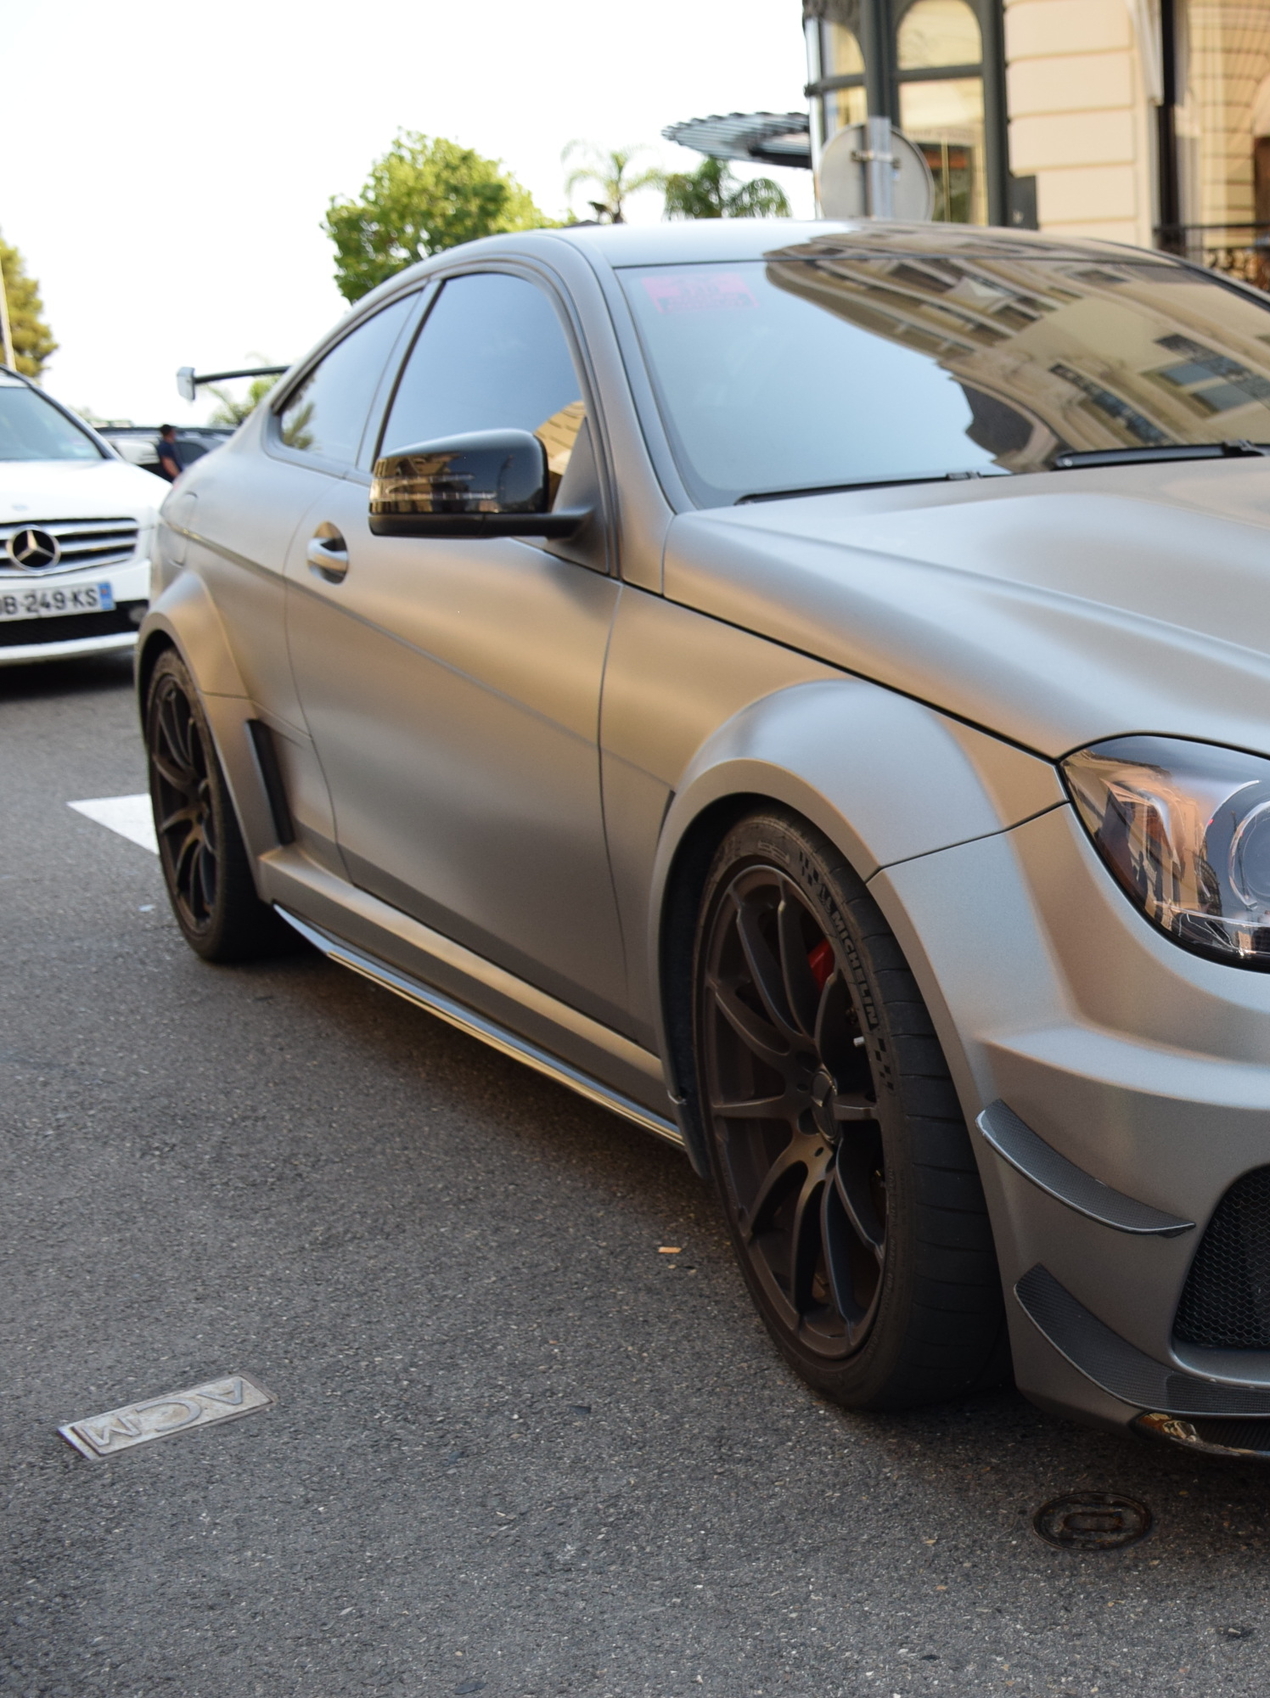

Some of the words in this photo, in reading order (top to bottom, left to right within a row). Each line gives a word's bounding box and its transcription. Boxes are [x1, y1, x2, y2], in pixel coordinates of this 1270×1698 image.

[0, 588, 97, 615] B-249-KS
[831, 911, 879, 1026] MICHELIN
[82, 1379, 244, 1447] ACM
